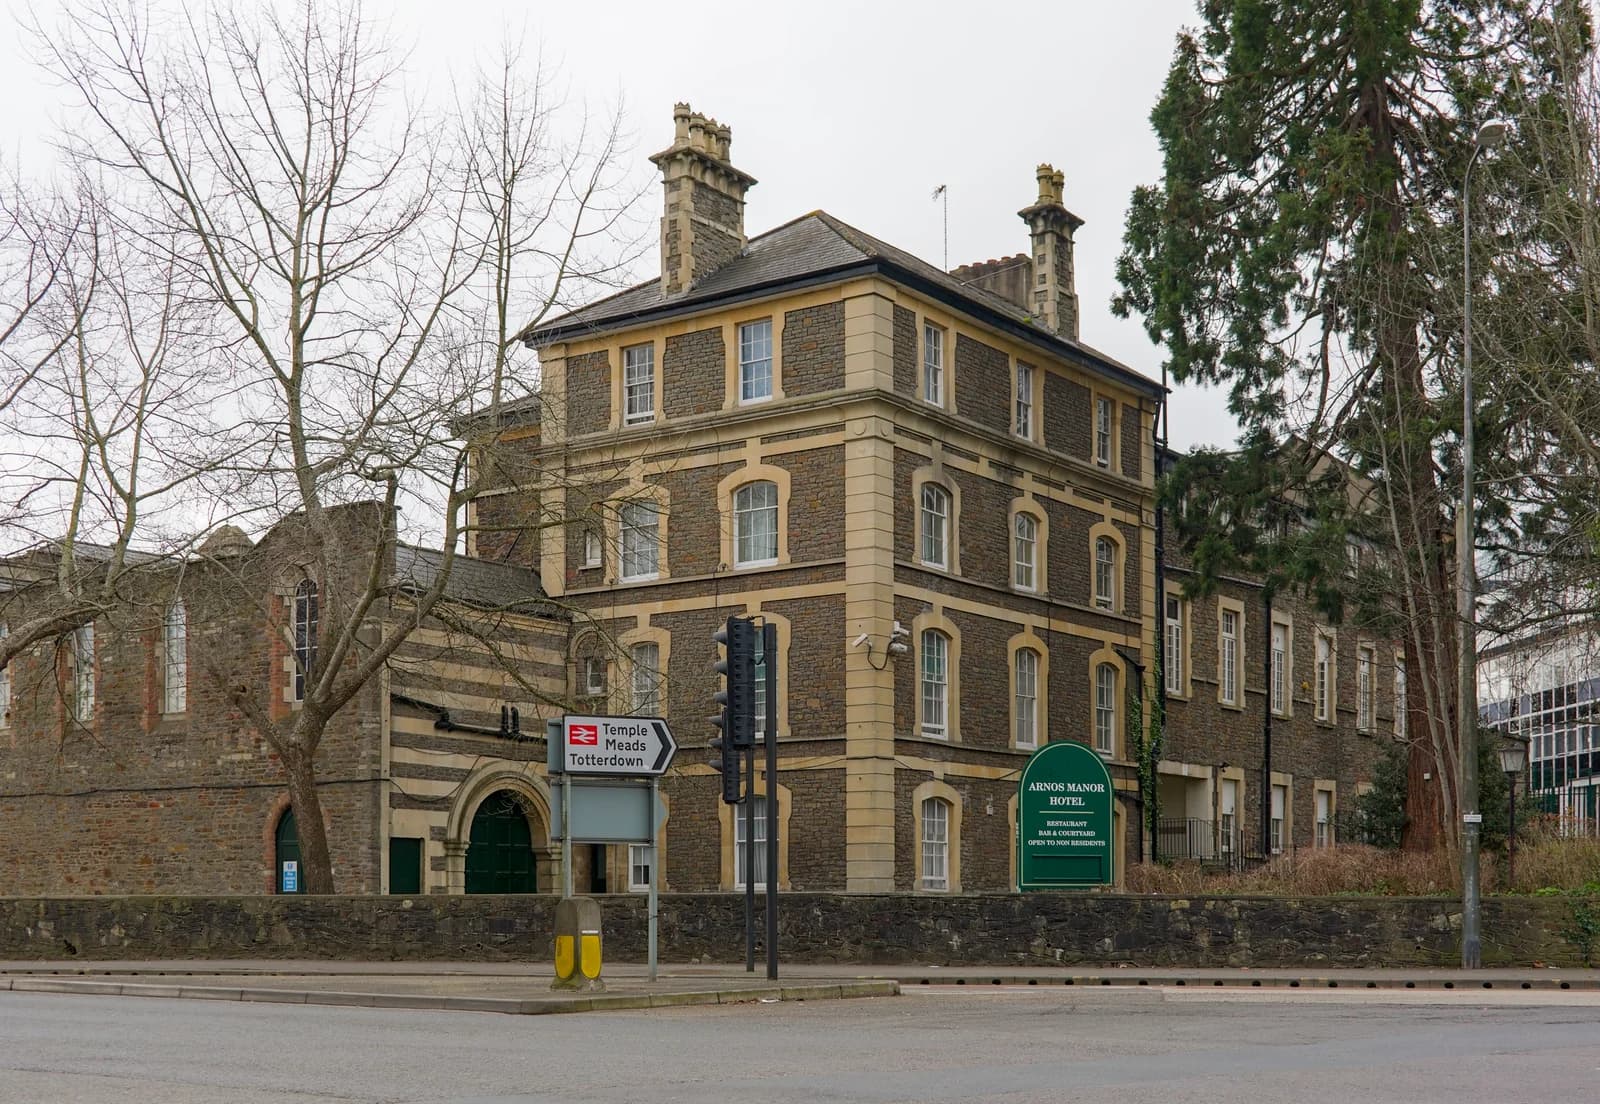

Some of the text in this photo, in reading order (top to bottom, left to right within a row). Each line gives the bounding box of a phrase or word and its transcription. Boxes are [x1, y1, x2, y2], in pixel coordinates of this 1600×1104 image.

[602, 723, 648, 738] Temple
[605, 739, 646, 752] Meads
[569, 753, 644, 767] Totterdown
[1028, 782, 1105, 793] ARNOS MANOR
[1049, 796, 1085, 806] HOTEL
